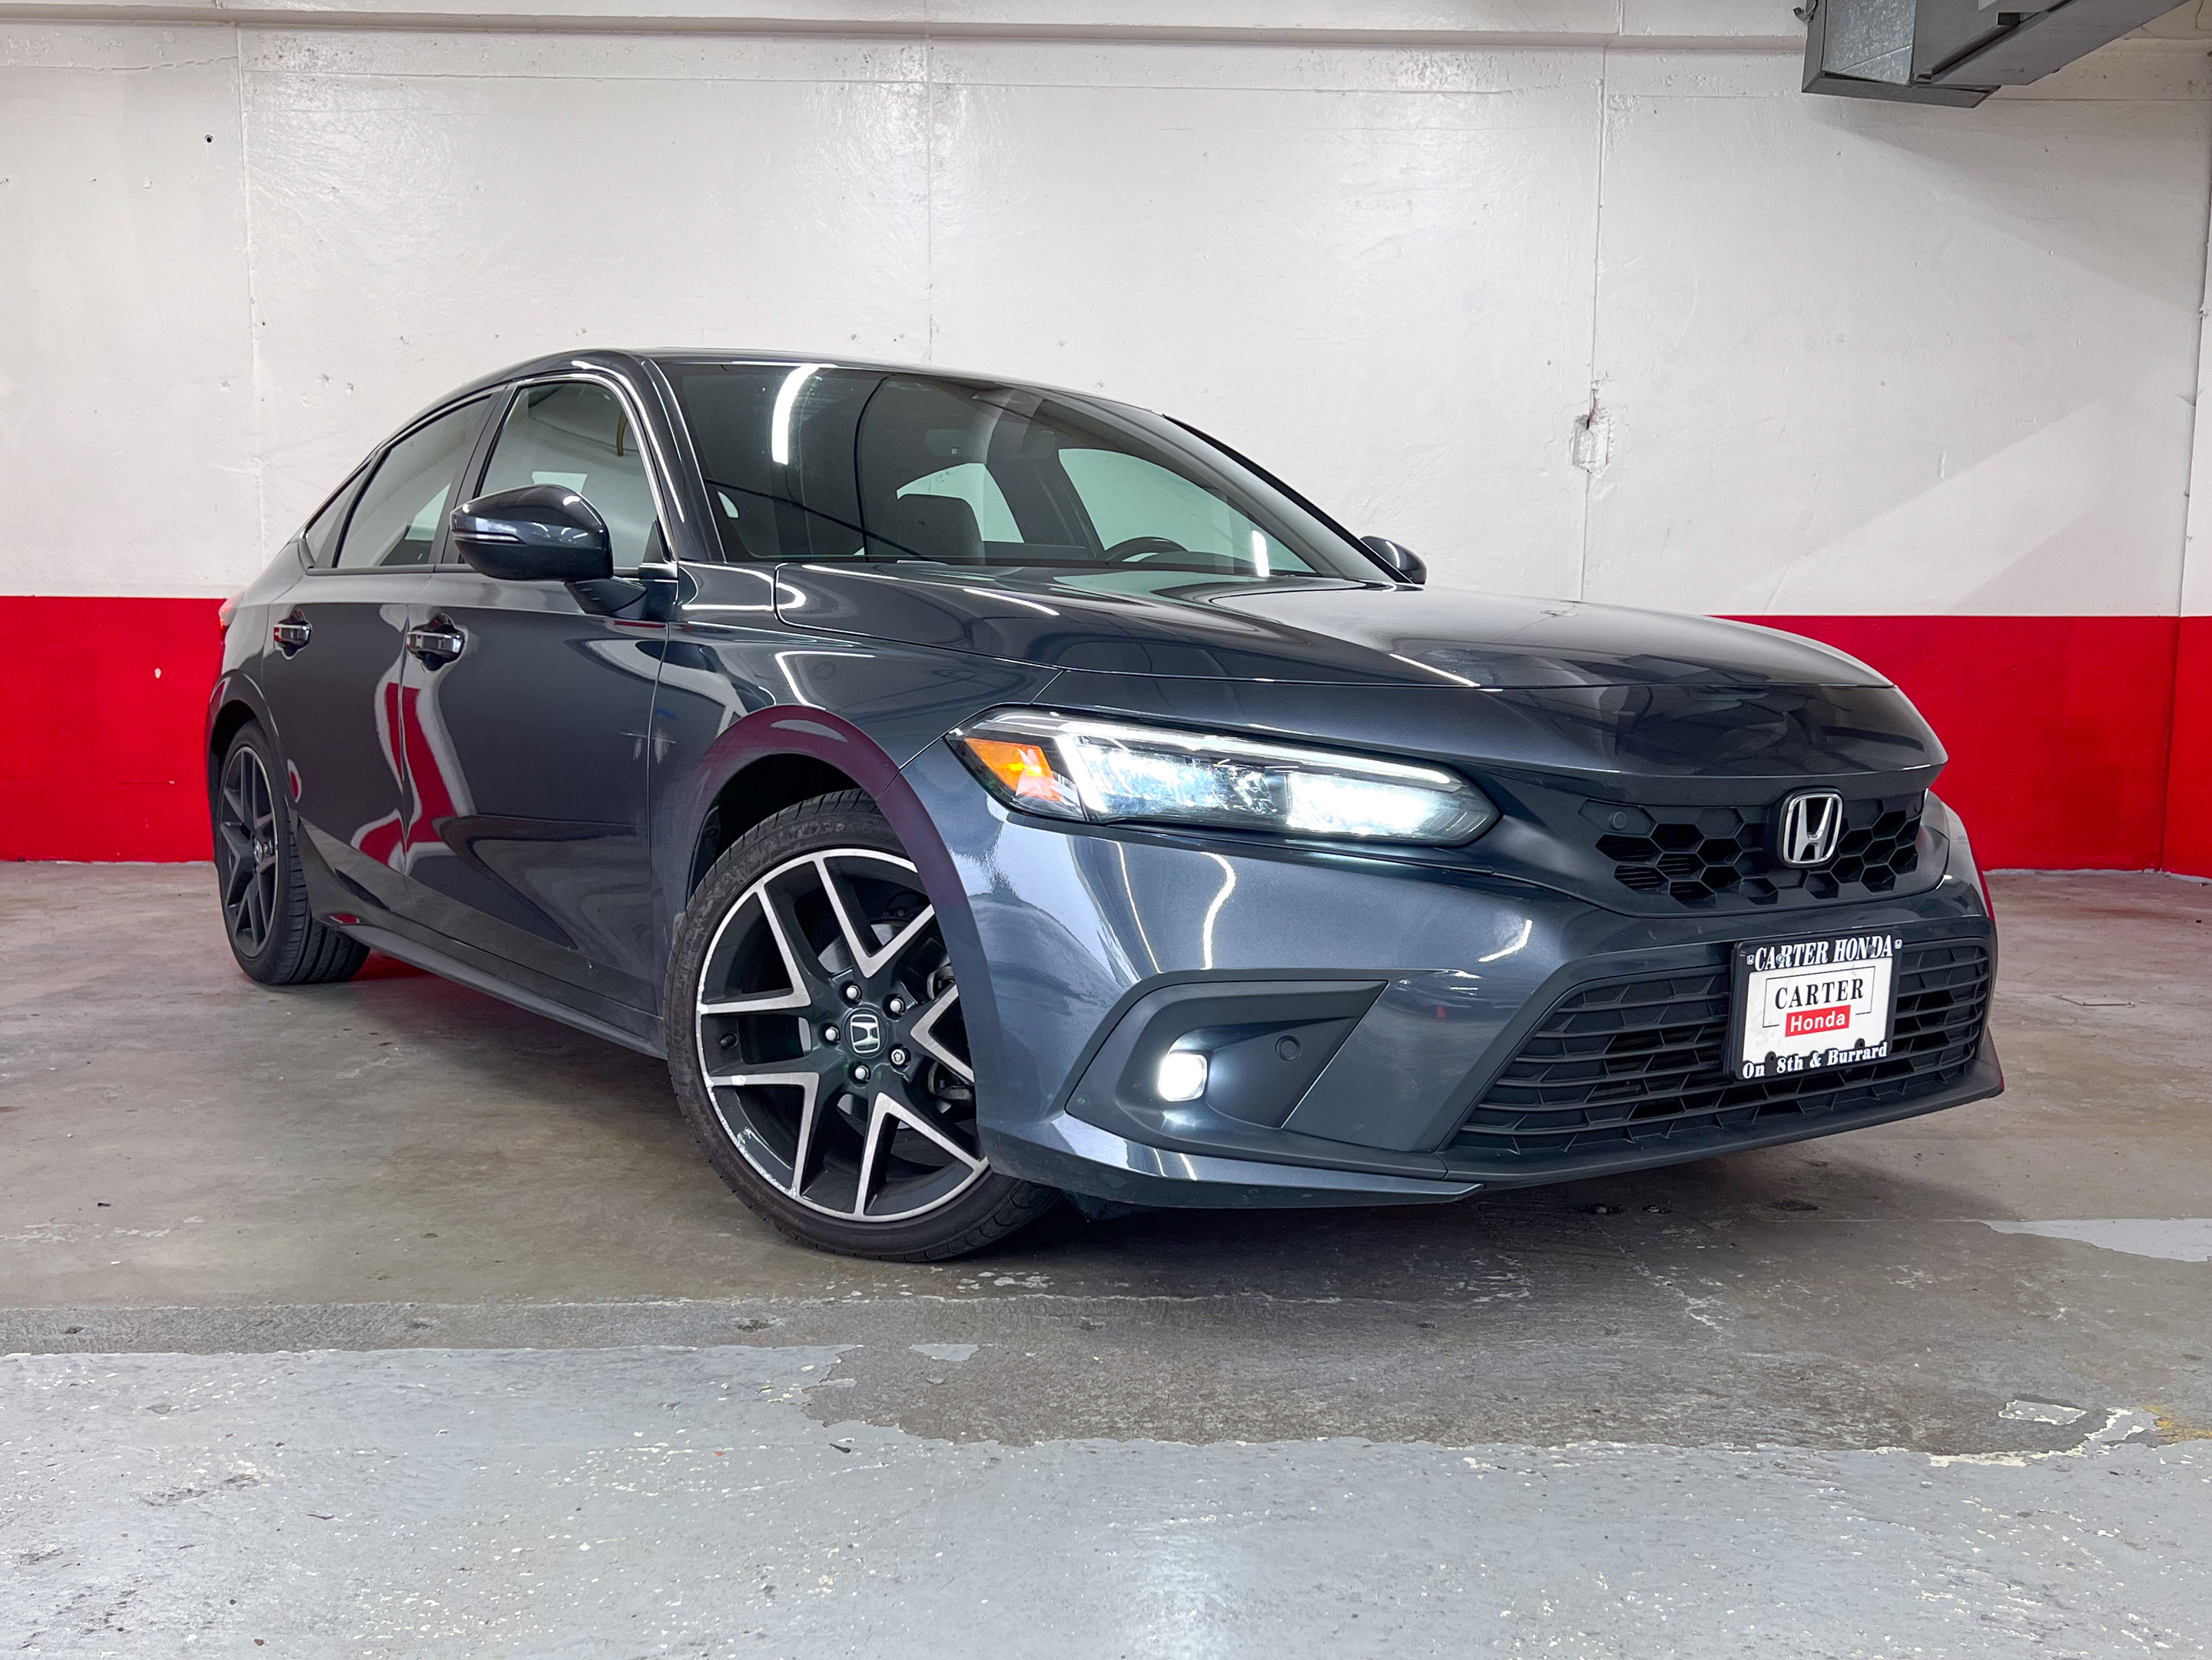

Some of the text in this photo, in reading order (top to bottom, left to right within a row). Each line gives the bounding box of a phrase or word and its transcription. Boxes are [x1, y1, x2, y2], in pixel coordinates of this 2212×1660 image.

[1754, 935, 1893, 971] CARTER HONDA
[1775, 978, 1864, 1010] CARTER
[1790, 1011, 1846, 1033] Honda
[1743, 1041, 1888, 1078] On 8th & Burrard
